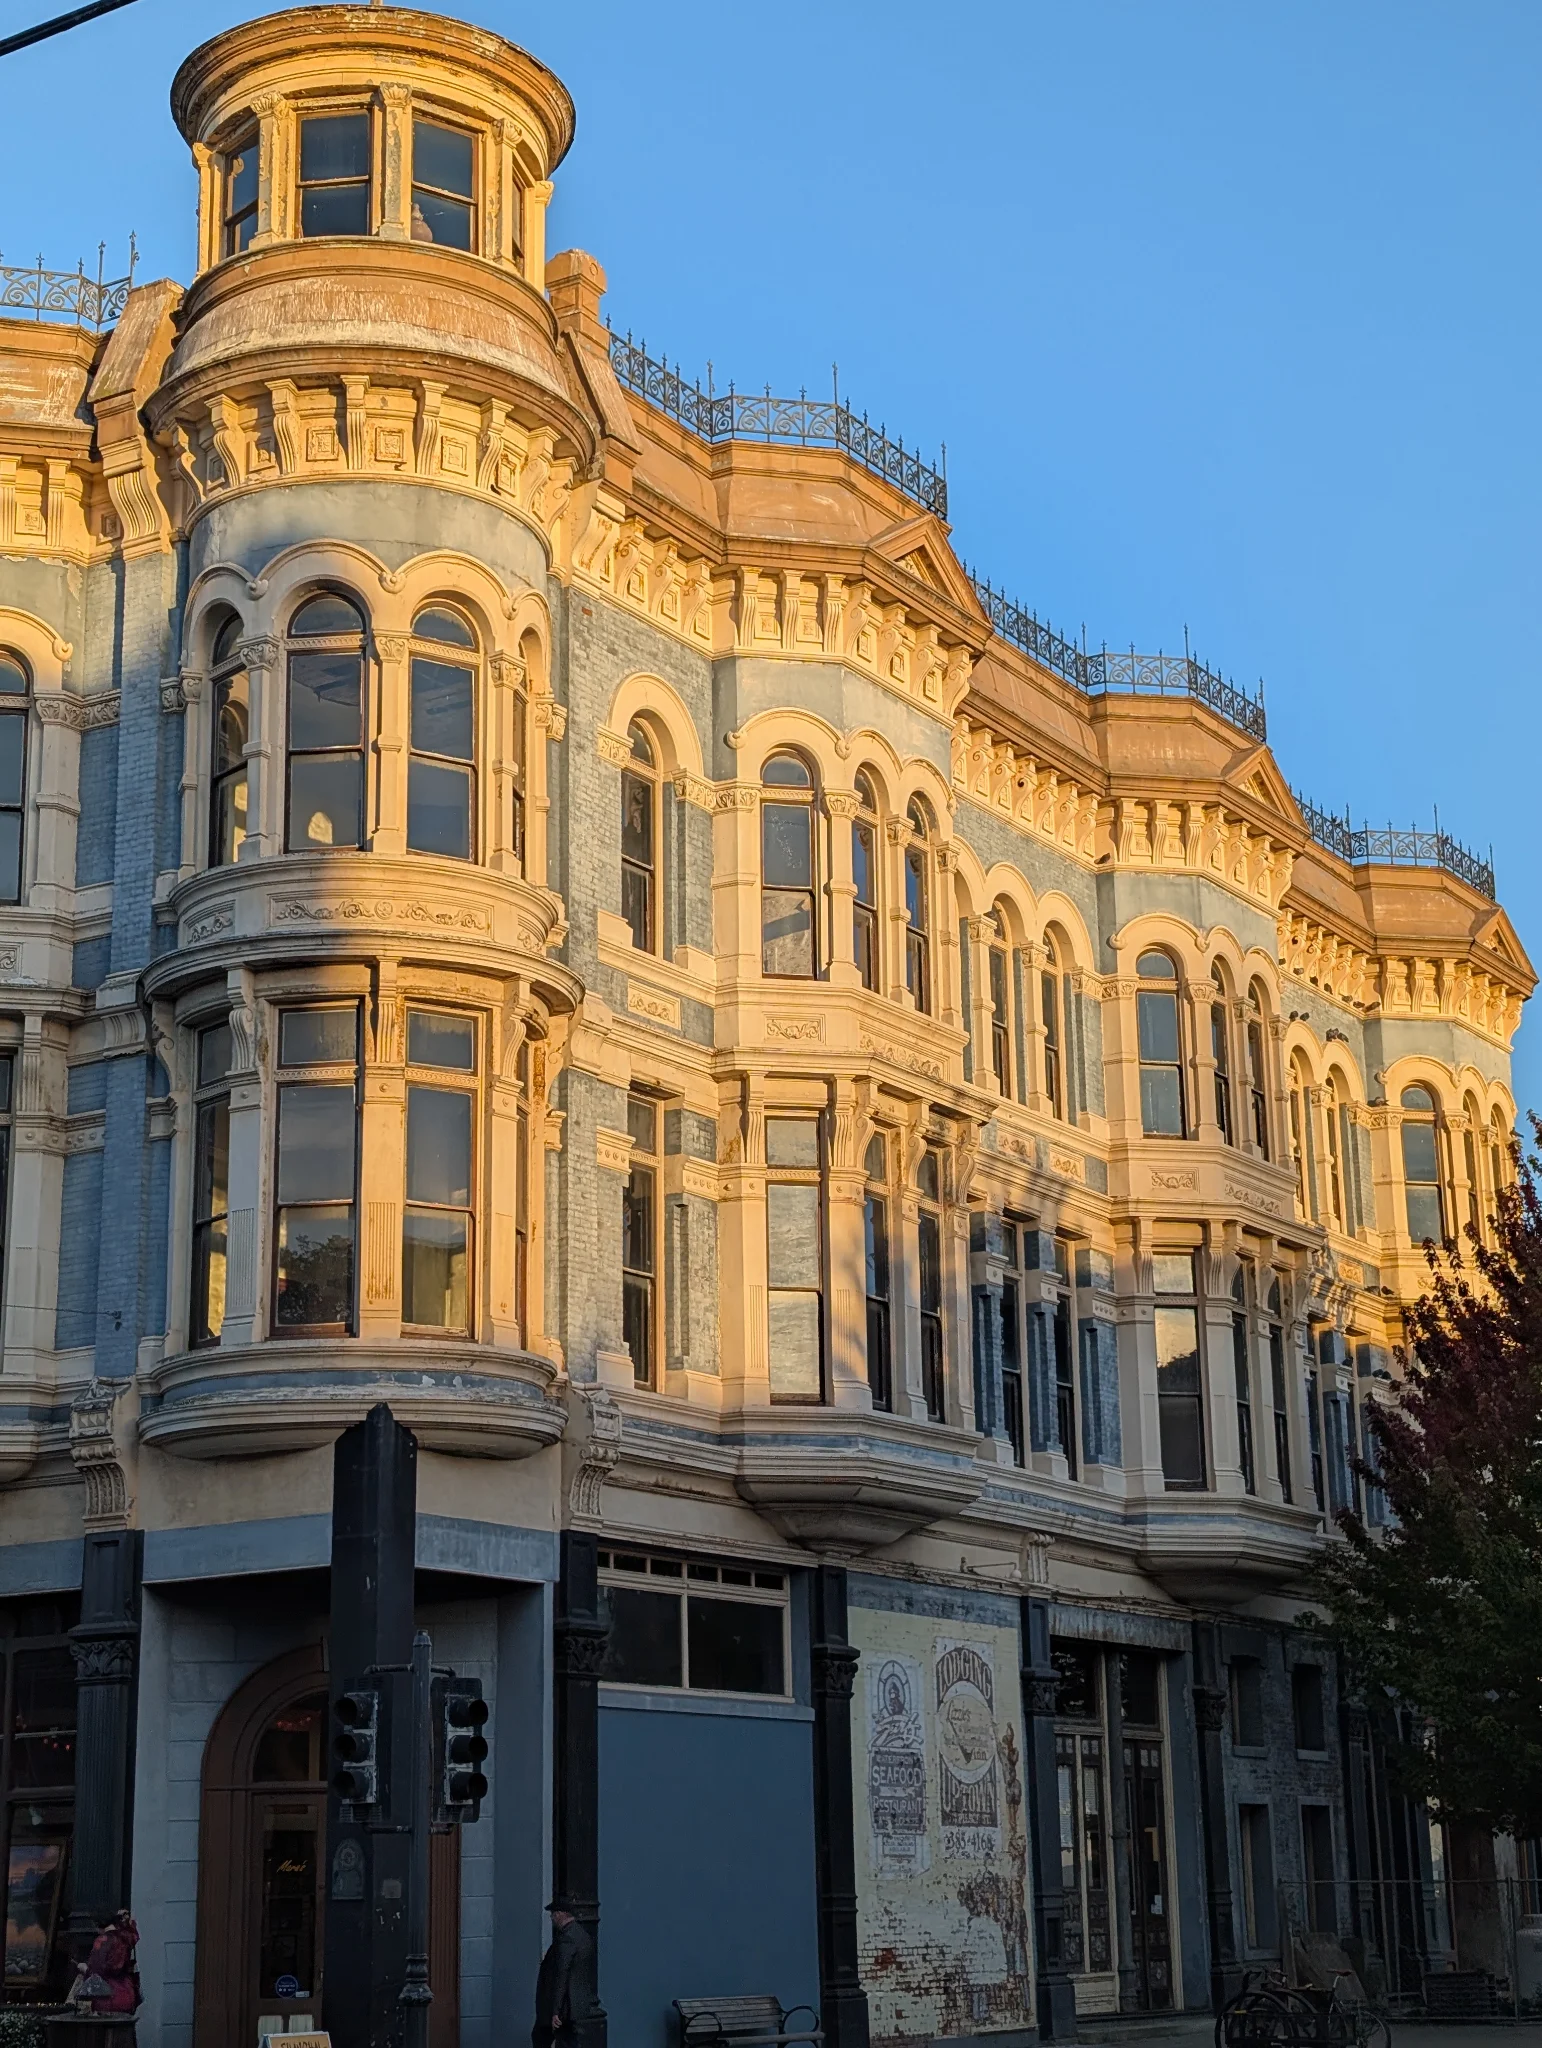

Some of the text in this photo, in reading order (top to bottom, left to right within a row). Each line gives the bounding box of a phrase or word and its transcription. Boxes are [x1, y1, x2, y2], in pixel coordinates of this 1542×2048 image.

[938, 1649, 992, 1701] LODGING
[872, 1765, 922, 1787] SEAFOOD
[942, 1760, 996, 1812] UPTOWN
[873, 1796, 922, 1814] RESTAURANT
